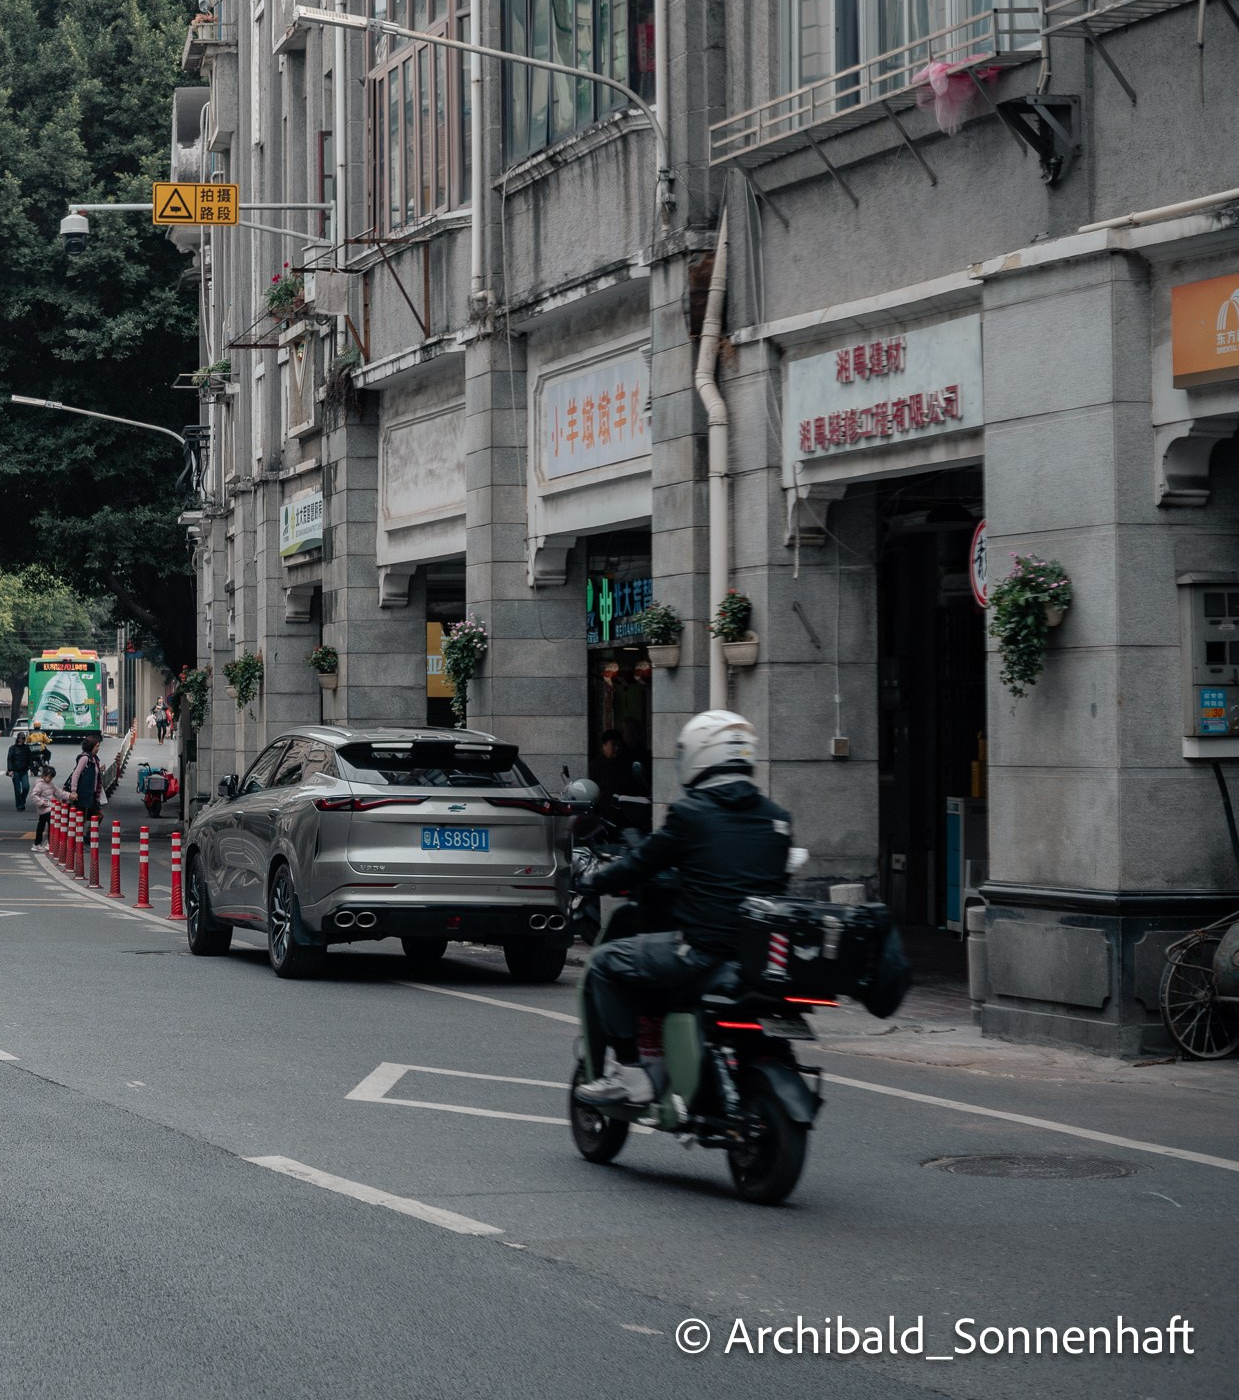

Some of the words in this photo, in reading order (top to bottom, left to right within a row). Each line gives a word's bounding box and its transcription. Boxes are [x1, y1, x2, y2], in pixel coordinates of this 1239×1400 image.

[200, 188, 231, 203] 拍摄
[200, 206, 231, 221] 路段
[836, 336, 906, 383] 湘粤建材
[800, 384, 962, 452] 湘粤装修工程有限公司
